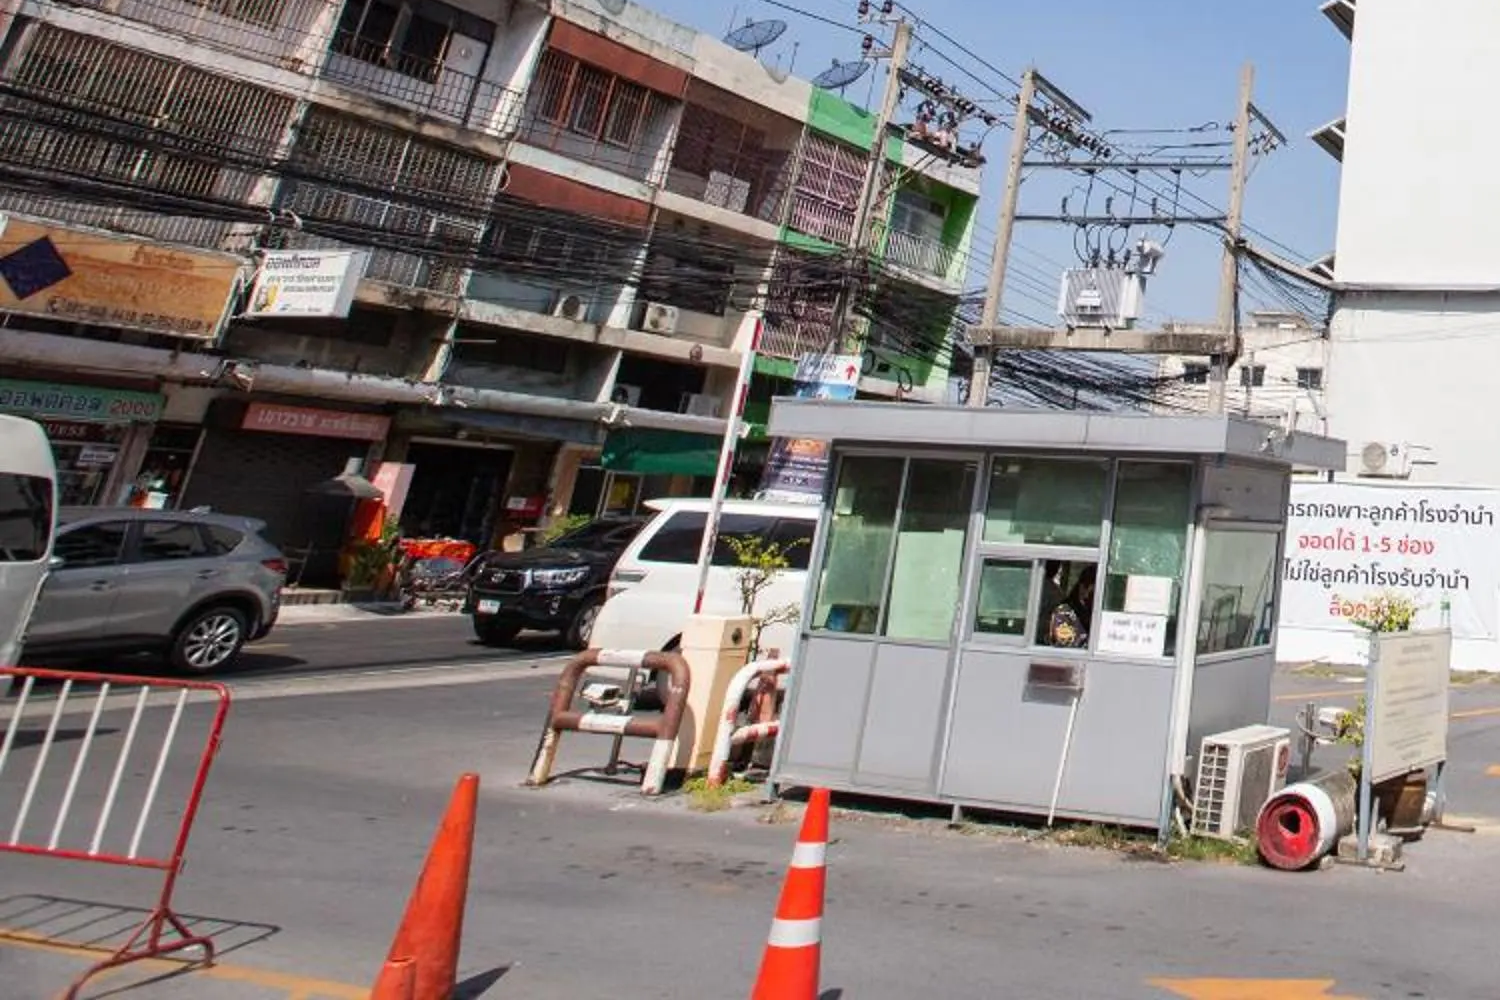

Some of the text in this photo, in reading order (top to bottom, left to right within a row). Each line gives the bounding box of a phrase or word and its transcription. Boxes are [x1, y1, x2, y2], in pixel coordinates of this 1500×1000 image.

[1298, 528, 1436, 555] จอดได้ 1-5 ช่อง
